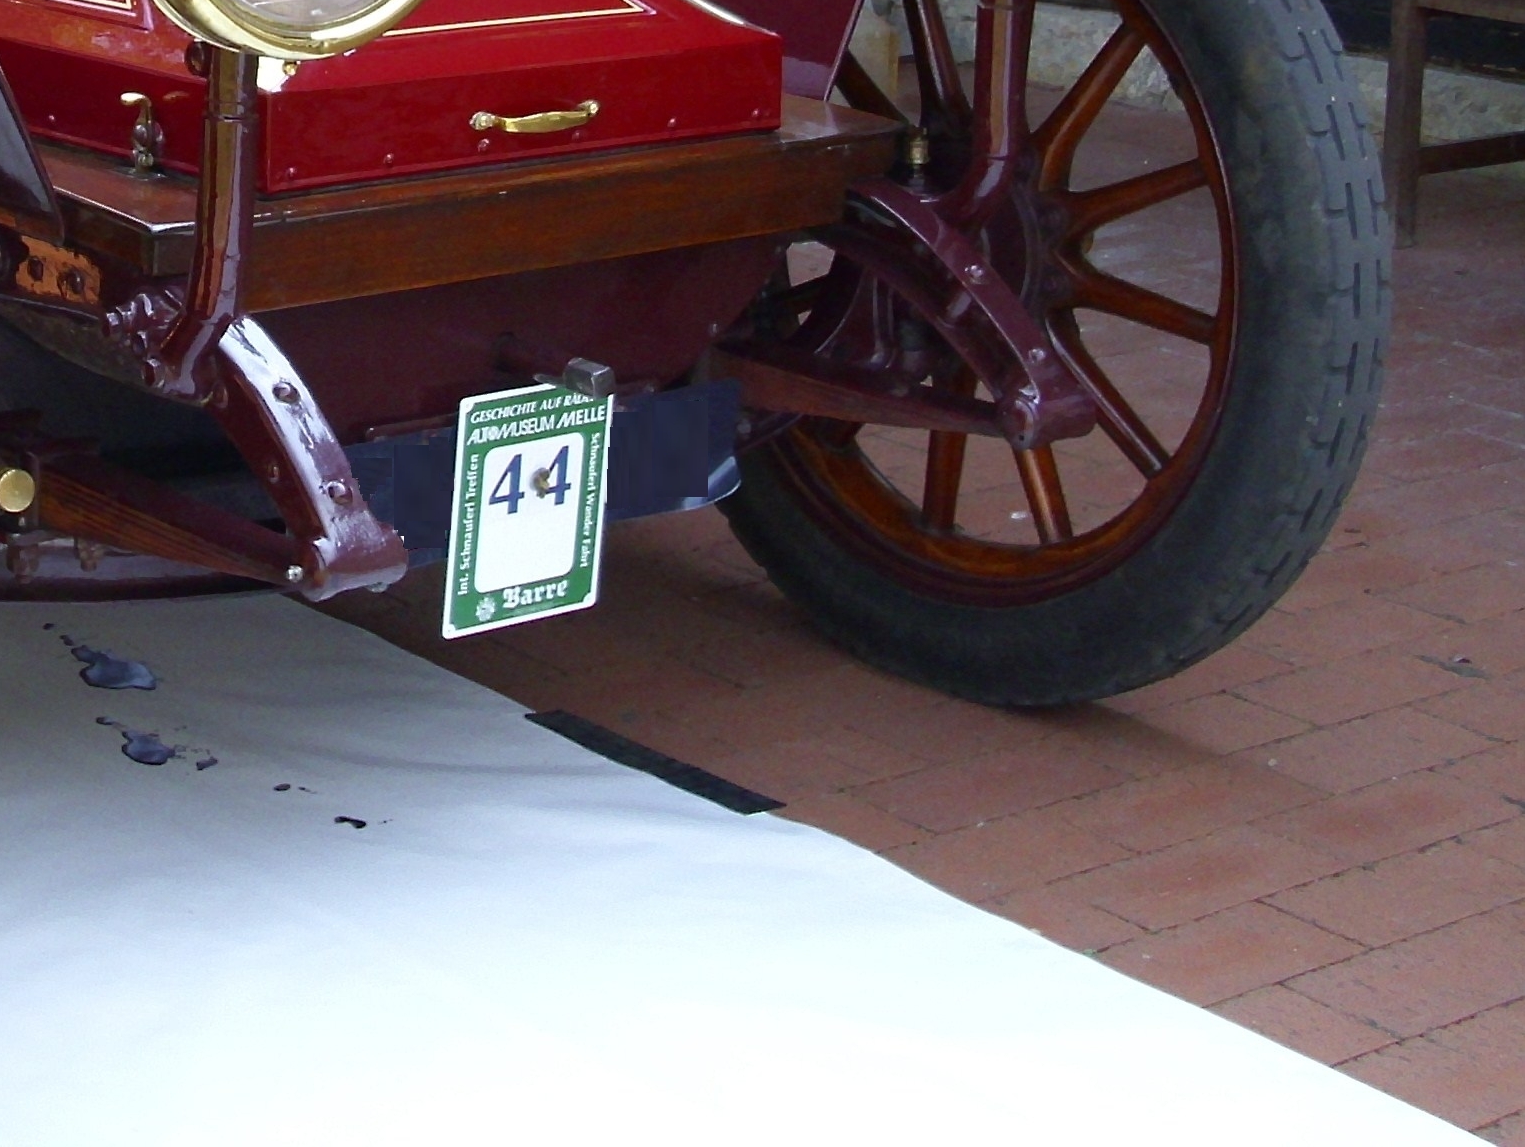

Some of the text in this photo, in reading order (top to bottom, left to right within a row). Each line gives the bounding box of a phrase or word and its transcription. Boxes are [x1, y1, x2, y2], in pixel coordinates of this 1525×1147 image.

[466, 405, 606, 445] AUTOMUSEUM MELLE
[470, 401, 538, 424] GESCHICHTE
[539, 397, 563, 411] AUF
[488, 445, 572, 514] 44
[502, 580, 568, 608] Barre
